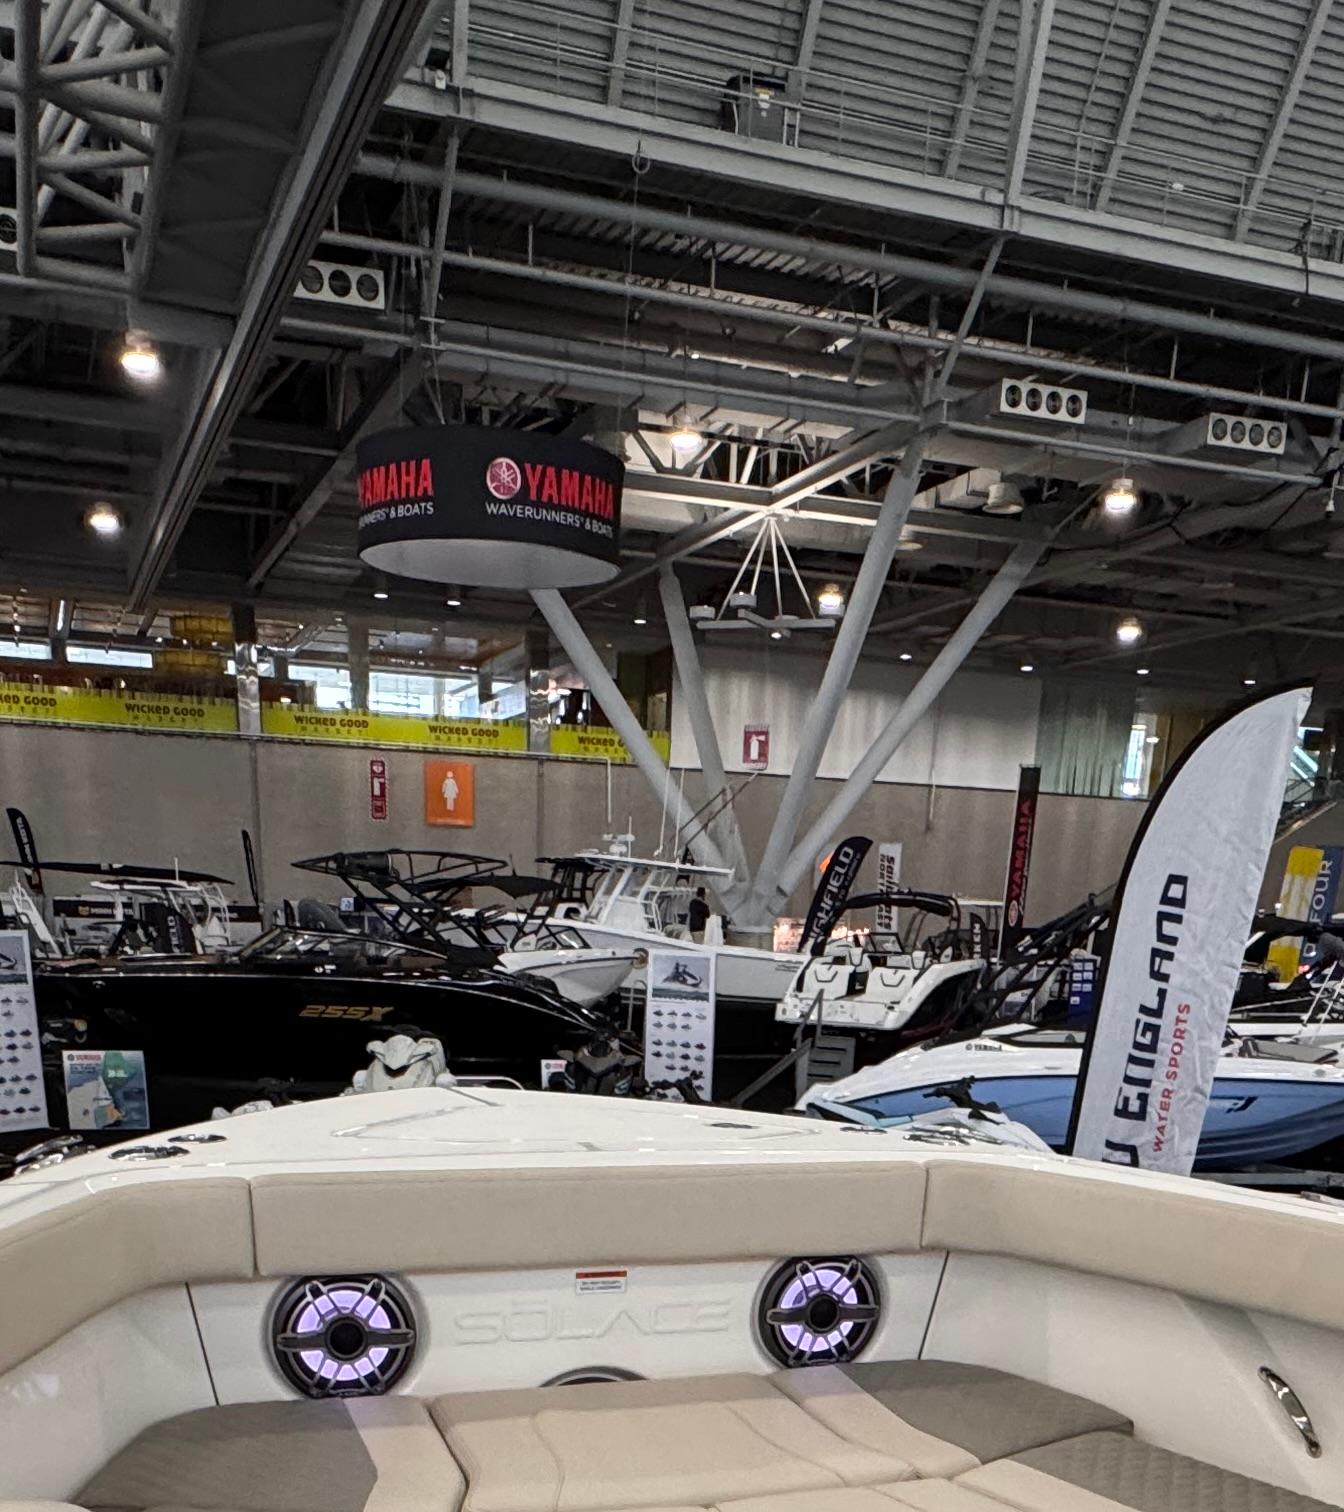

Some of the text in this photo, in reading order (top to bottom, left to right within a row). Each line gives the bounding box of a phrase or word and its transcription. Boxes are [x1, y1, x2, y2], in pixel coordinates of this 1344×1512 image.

[524, 462, 614, 520] YAMAHA
[397, 502, 434, 518] BOATS
[23, 695, 57, 707] GOOD
[173, 707, 205, 718] GOOD
[339, 718, 369, 729] GOOD
[471, 727, 500, 738] GOOD
[1114, 873, 1188, 1121] ENGLAND
[298, 1004, 394, 1021] 255X
[1153, 1003, 1191, 1153] WATER SPORTS
